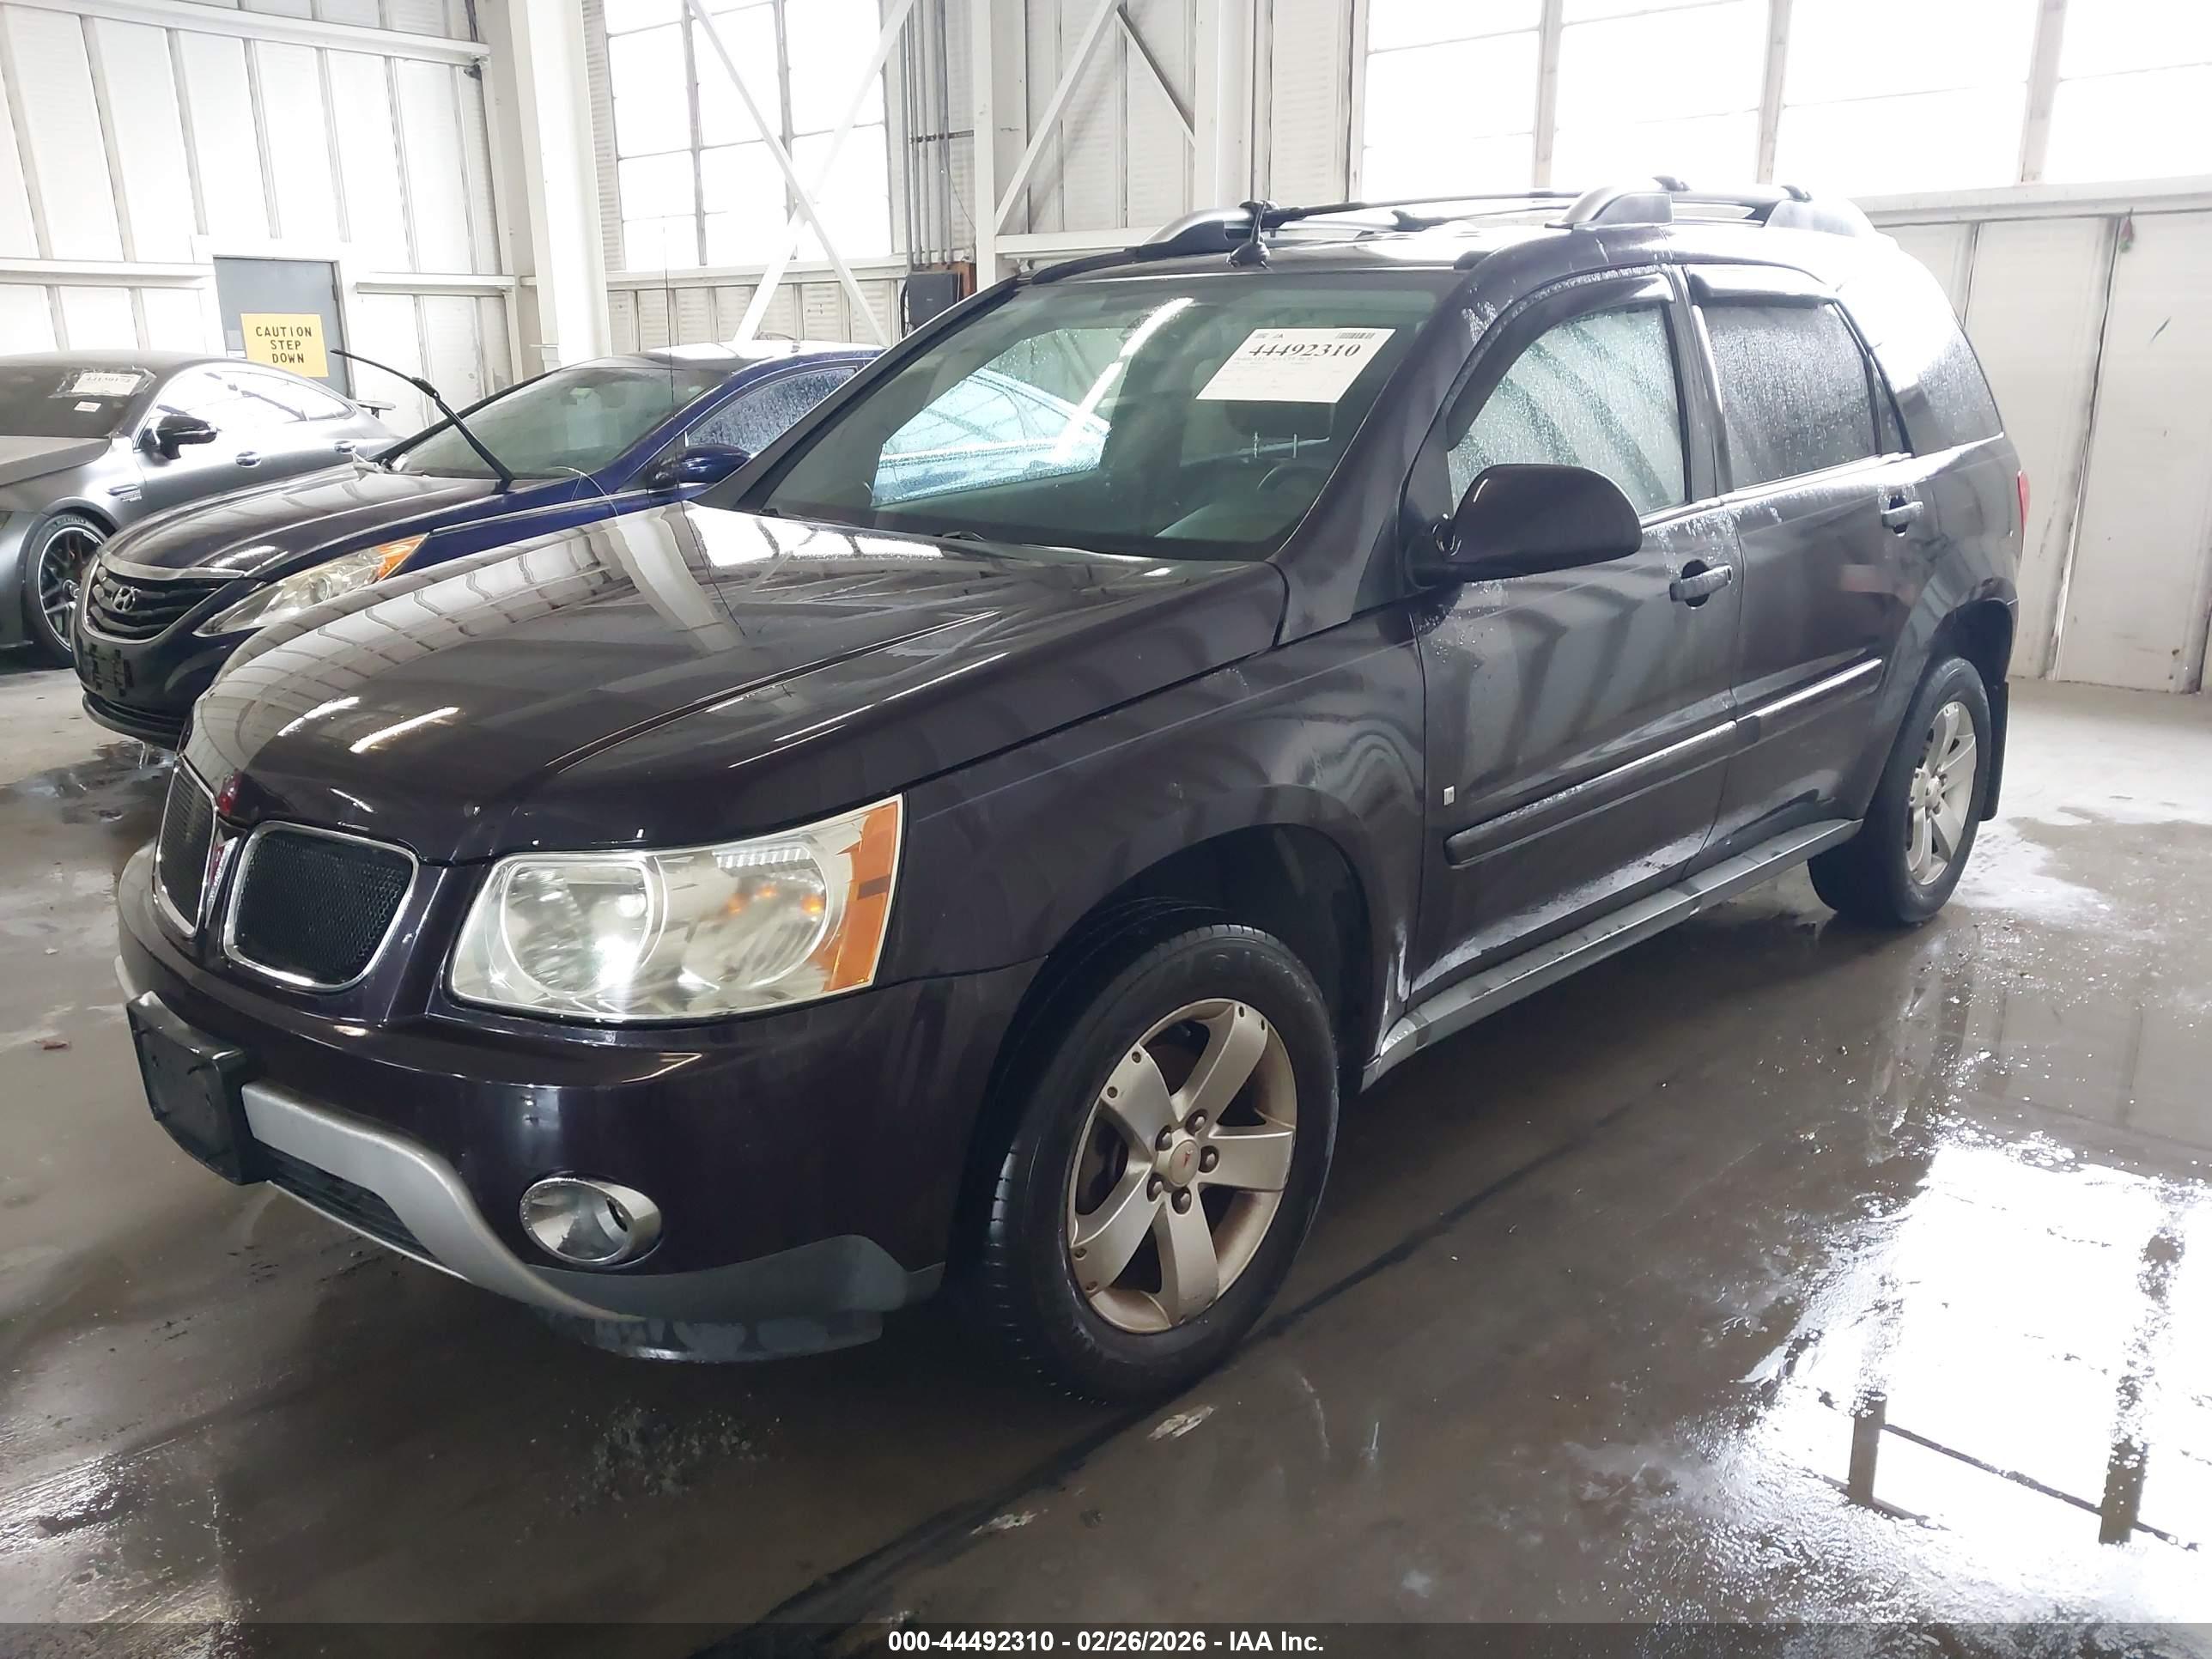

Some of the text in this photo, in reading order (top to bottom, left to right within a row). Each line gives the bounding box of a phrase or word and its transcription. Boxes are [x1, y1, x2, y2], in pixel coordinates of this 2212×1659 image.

[255, 326, 312, 337] CAUTION
[270, 339, 301, 350] STEP
[1249, 343, 1361, 357] 44492310
[271, 352, 305, 364] DOWN
